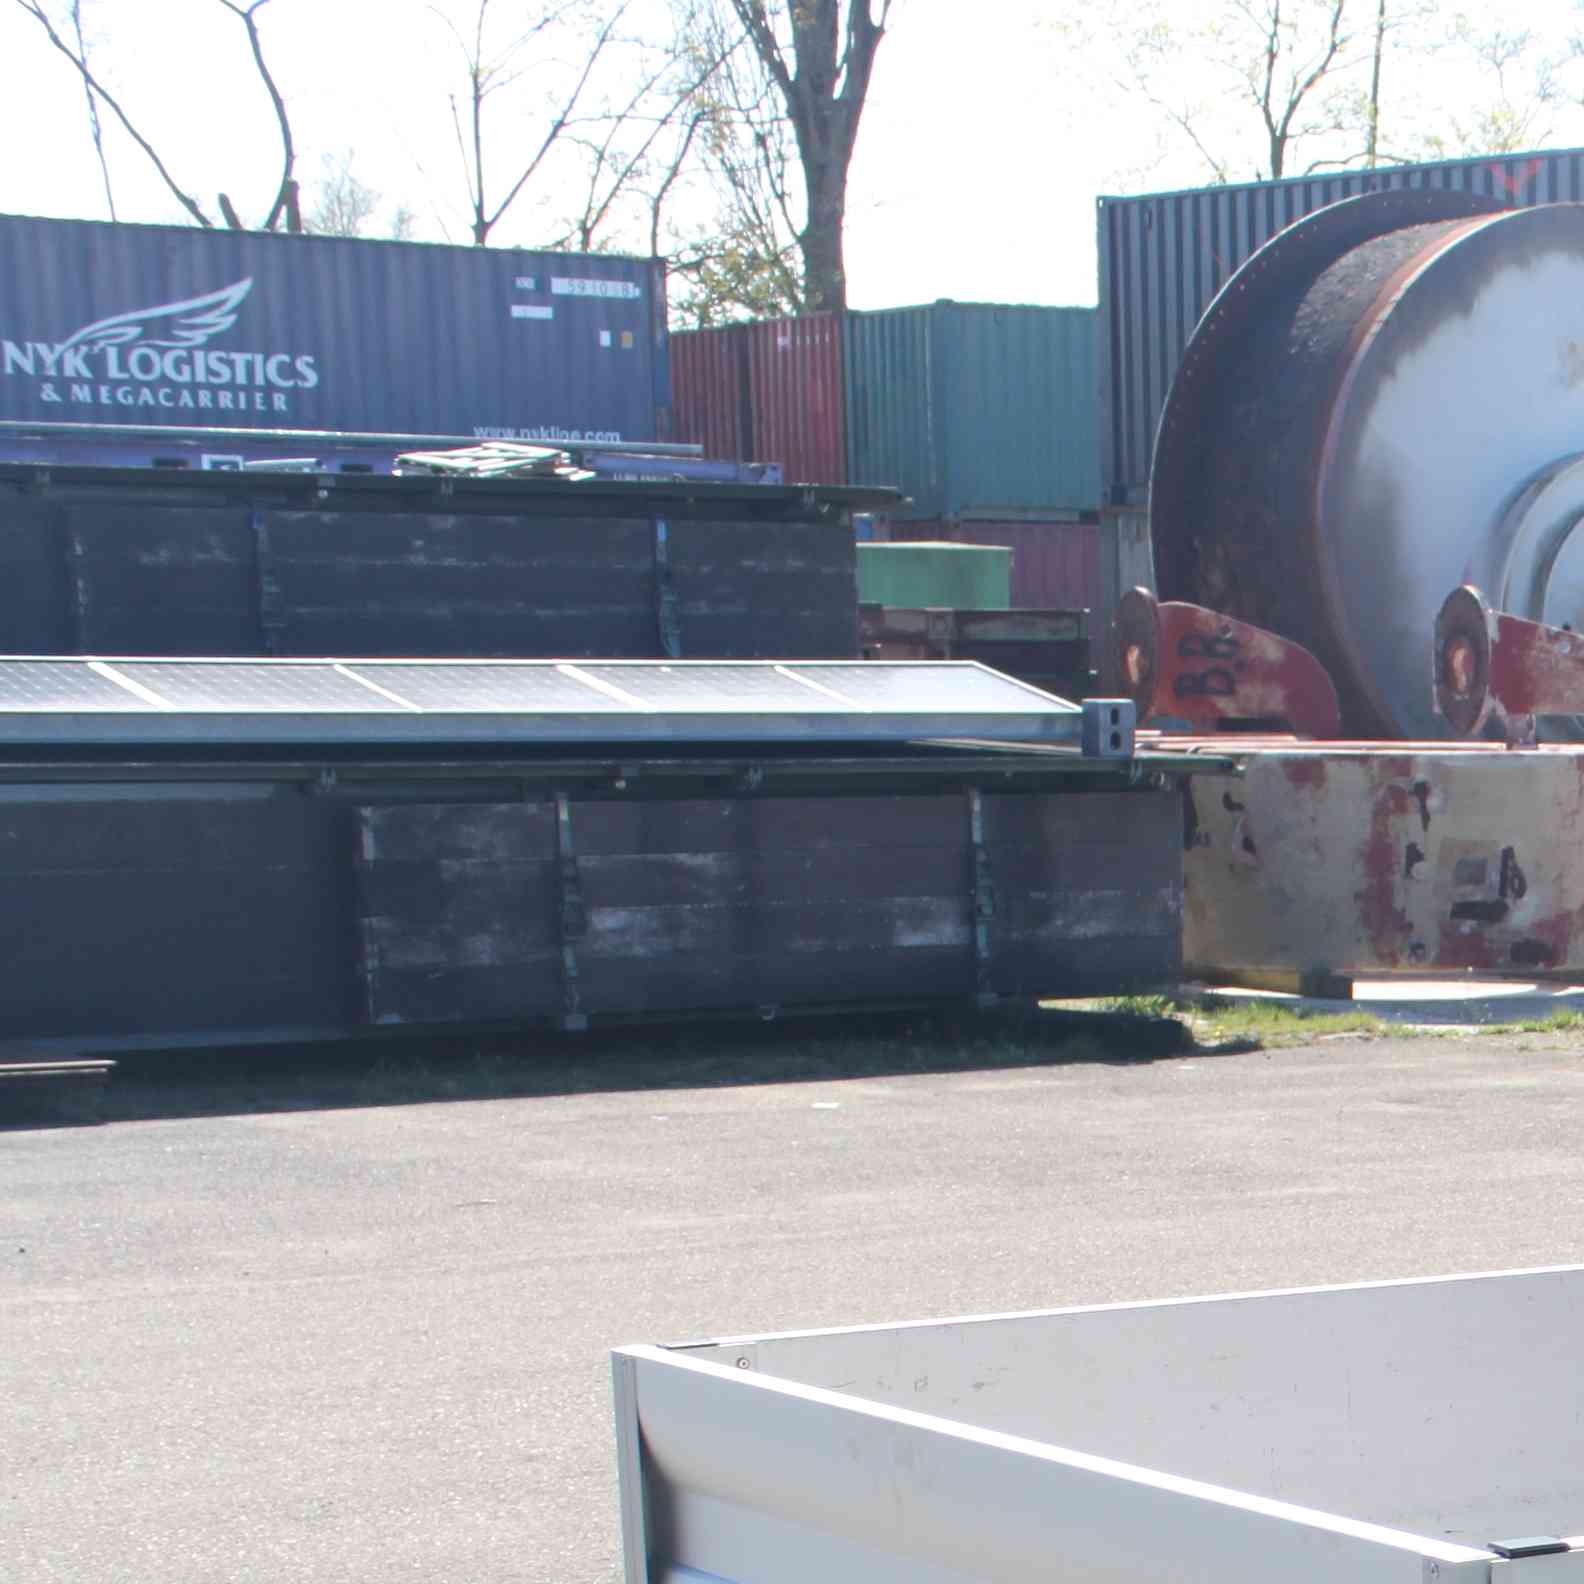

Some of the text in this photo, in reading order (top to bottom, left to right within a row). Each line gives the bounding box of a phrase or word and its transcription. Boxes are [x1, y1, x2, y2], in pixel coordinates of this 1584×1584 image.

[1, 339, 319, 388] NYK LOGISTICS
[40, 382, 289, 411] & MEGACARRIER
